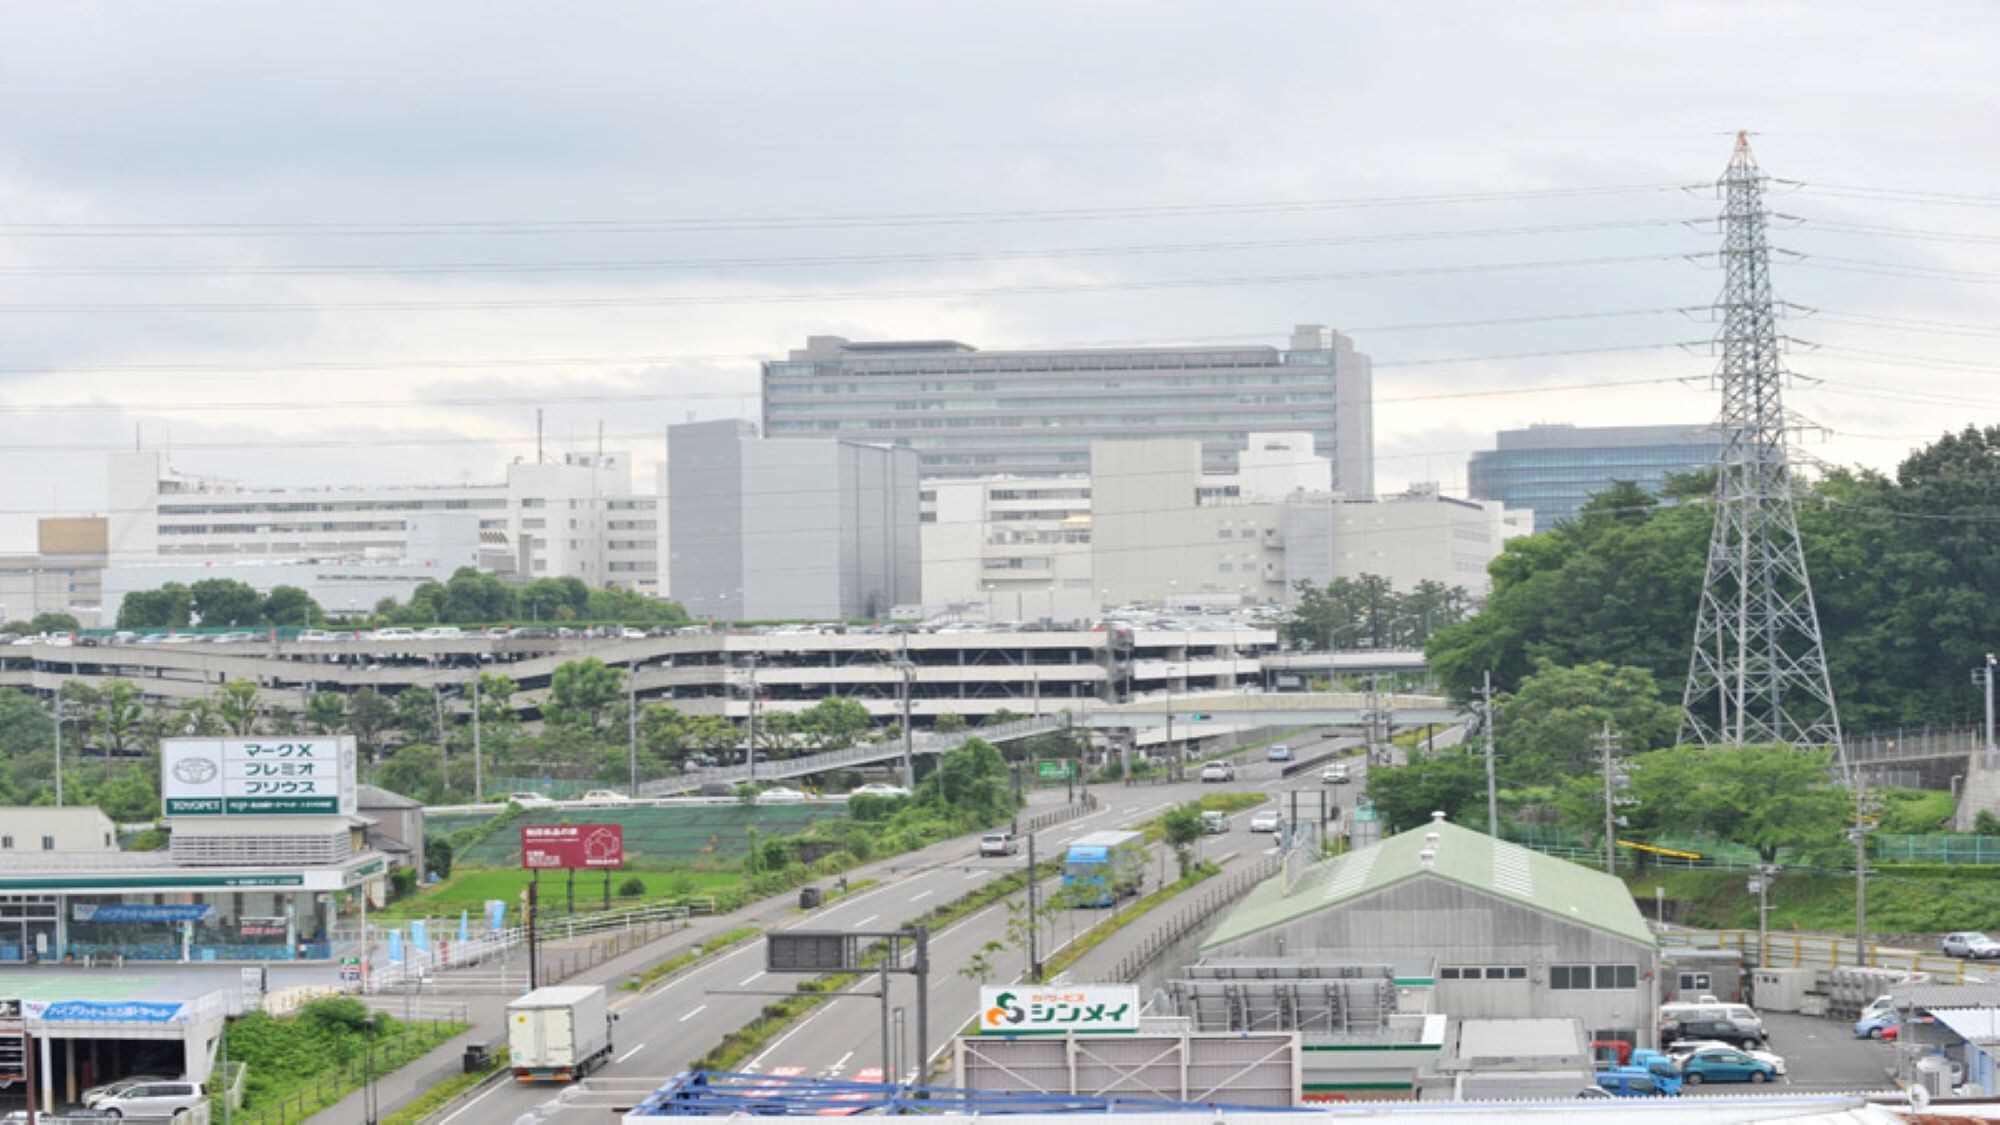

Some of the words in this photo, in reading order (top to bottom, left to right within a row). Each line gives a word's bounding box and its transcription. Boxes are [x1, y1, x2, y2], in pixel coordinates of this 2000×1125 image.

[245, 743, 312, 757] マークX
[245, 762, 315, 775] プレミオ
[1032, 1003, 1129, 1022] シンメイ
